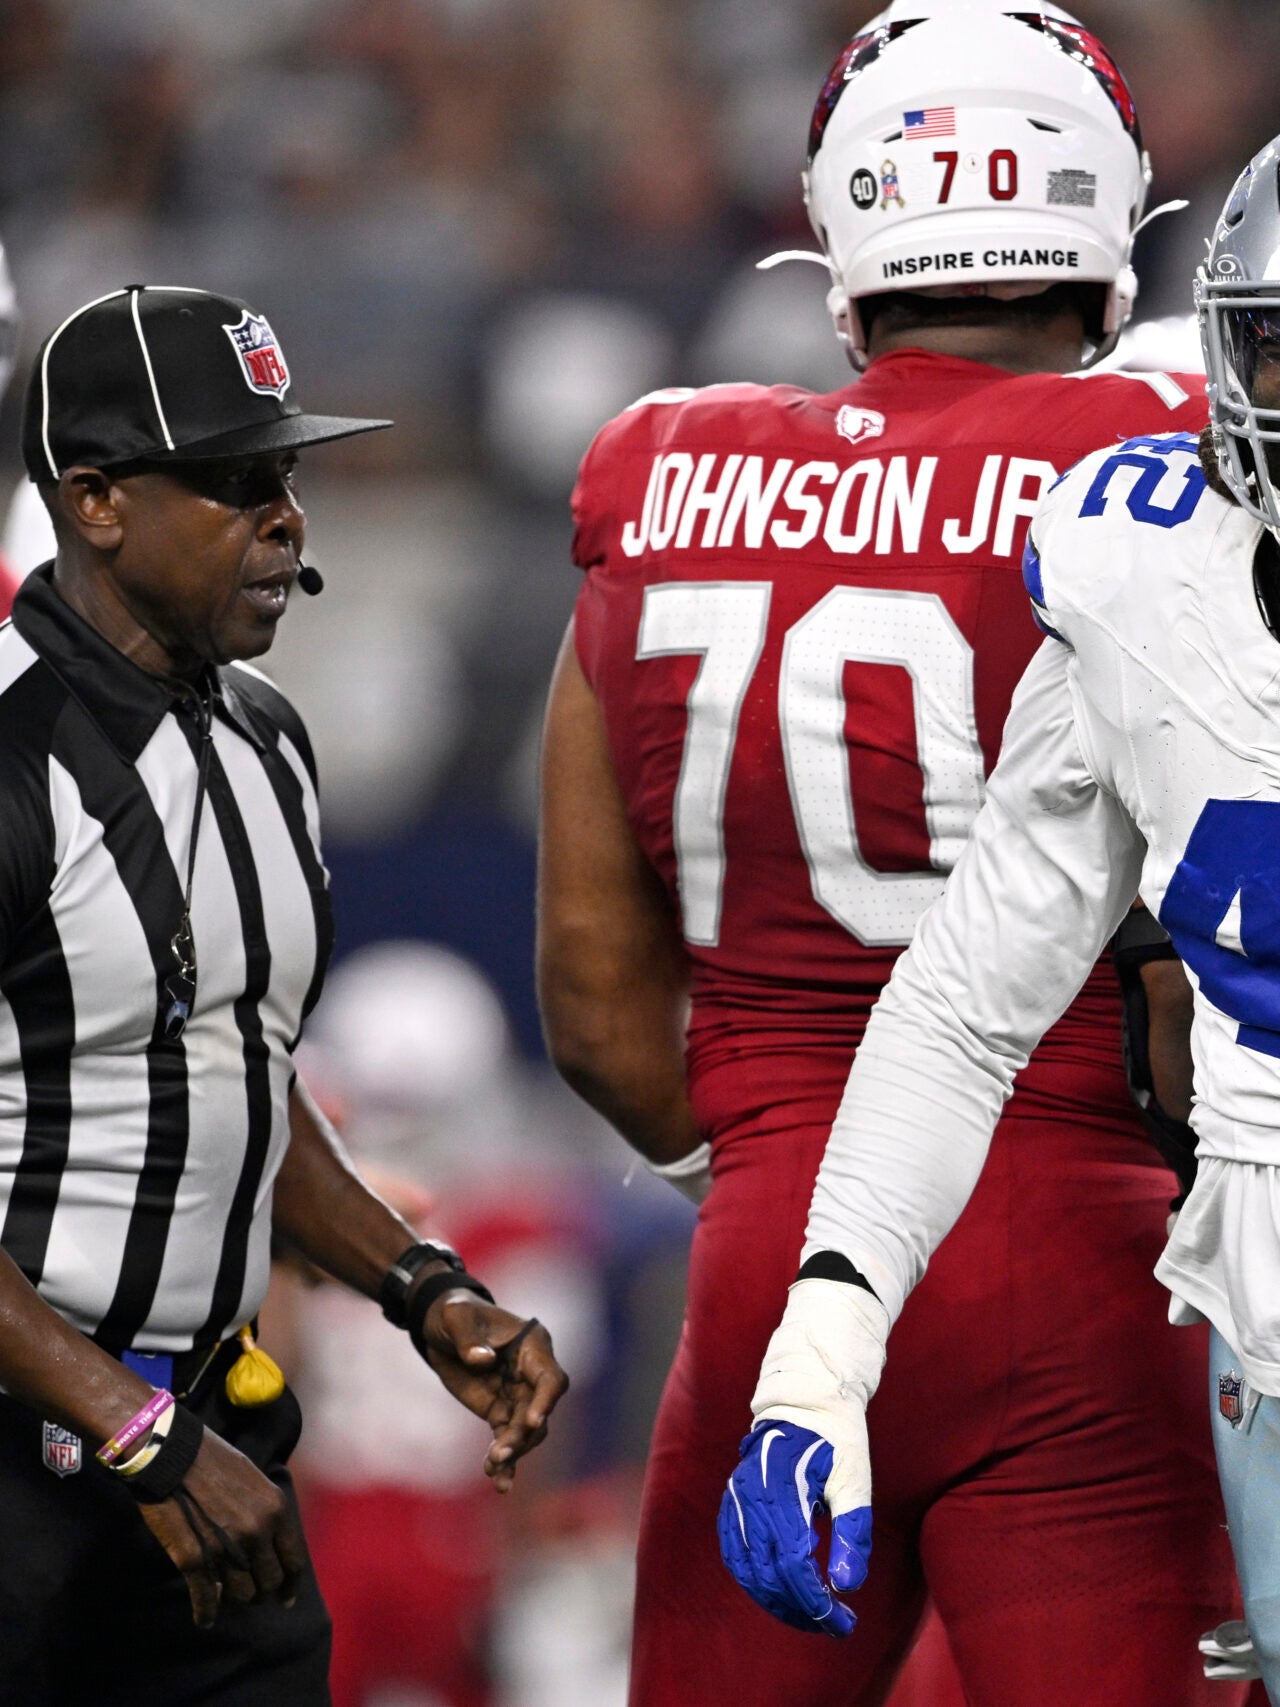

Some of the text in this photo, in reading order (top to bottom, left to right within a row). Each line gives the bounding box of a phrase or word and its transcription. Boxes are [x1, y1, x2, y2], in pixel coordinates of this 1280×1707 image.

[853, 176, 873, 201] 40
[883, 249, 1080, 279] INSPIRE CHANGE
[244, 347, 287, 388] NFL
[620, 451, 938, 558] JOHNSON
[635, 580, 986, 948] 70
[1221, 1396, 1239, 1416] NFL
[48, 1446, 78, 1469] NFL
